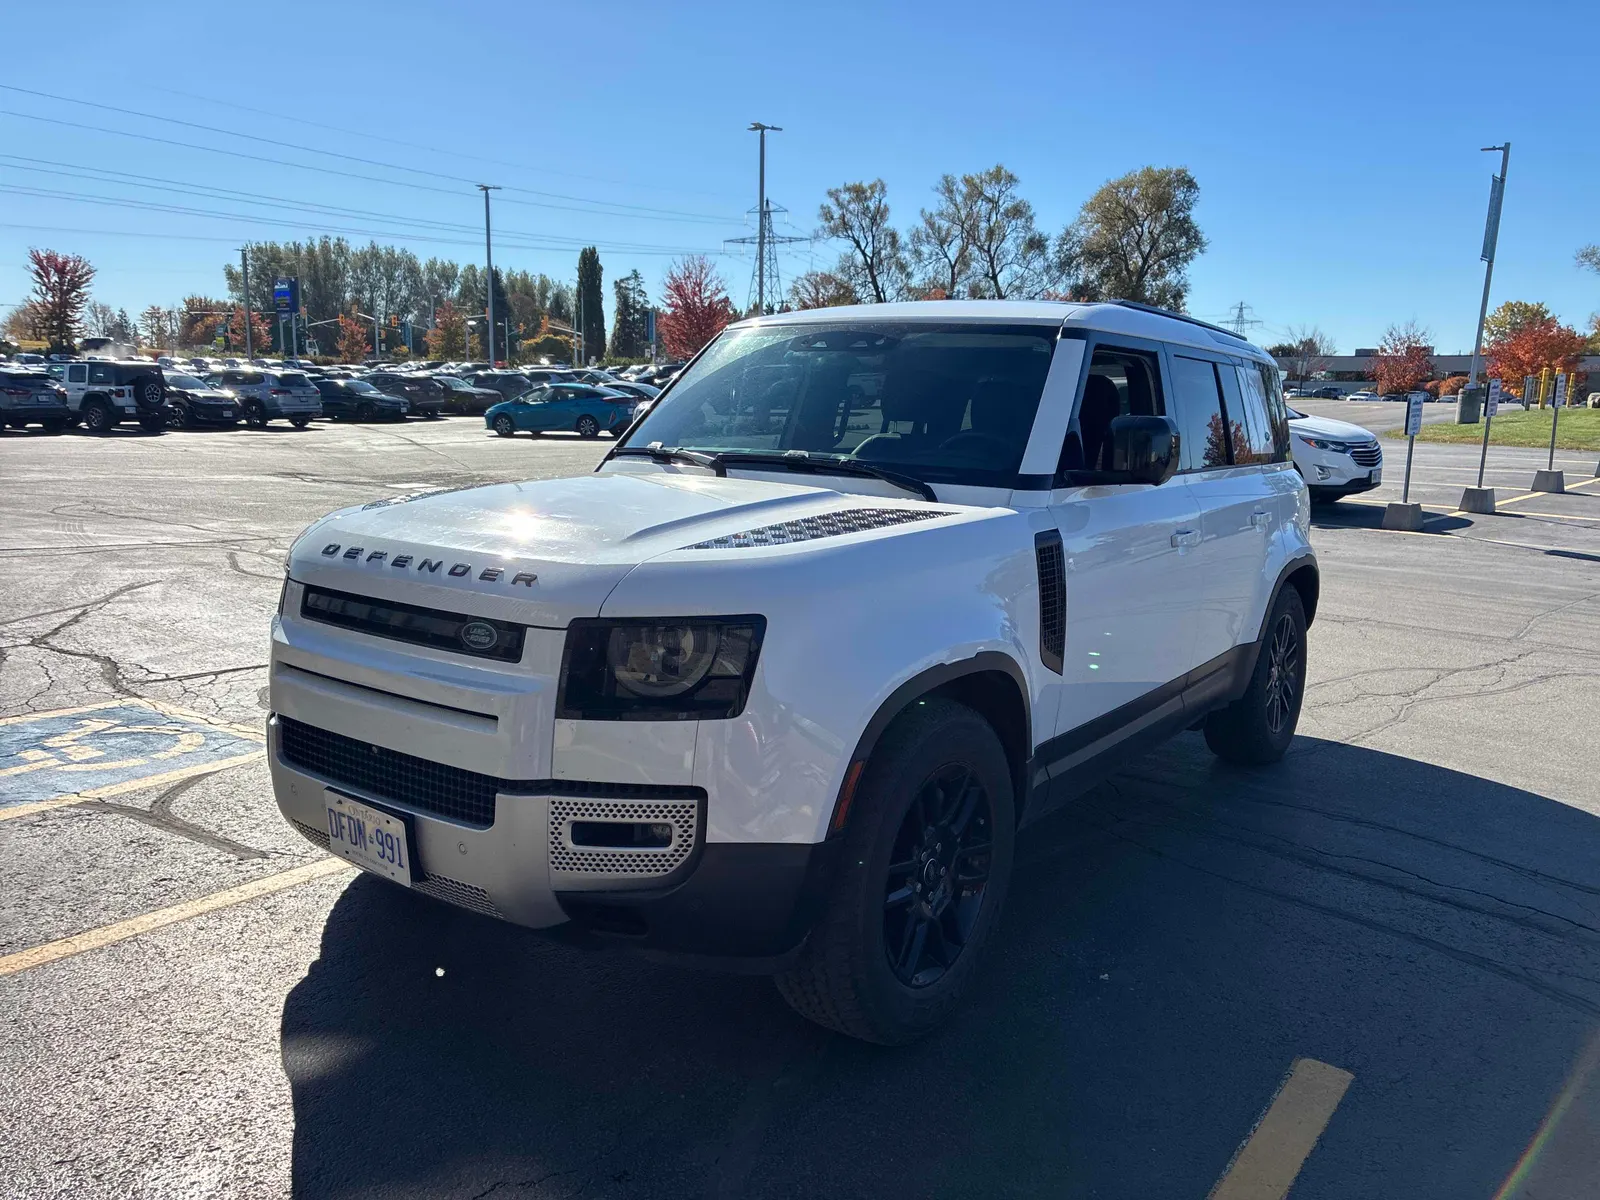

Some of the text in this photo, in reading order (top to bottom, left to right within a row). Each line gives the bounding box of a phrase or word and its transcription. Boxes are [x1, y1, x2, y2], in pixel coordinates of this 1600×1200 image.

[321, 543, 538, 588] DEFENDER
[470, 634, 490, 643] ROVER
[327, 808, 367, 851] DFDN
[375, 828, 404, 869] 991
